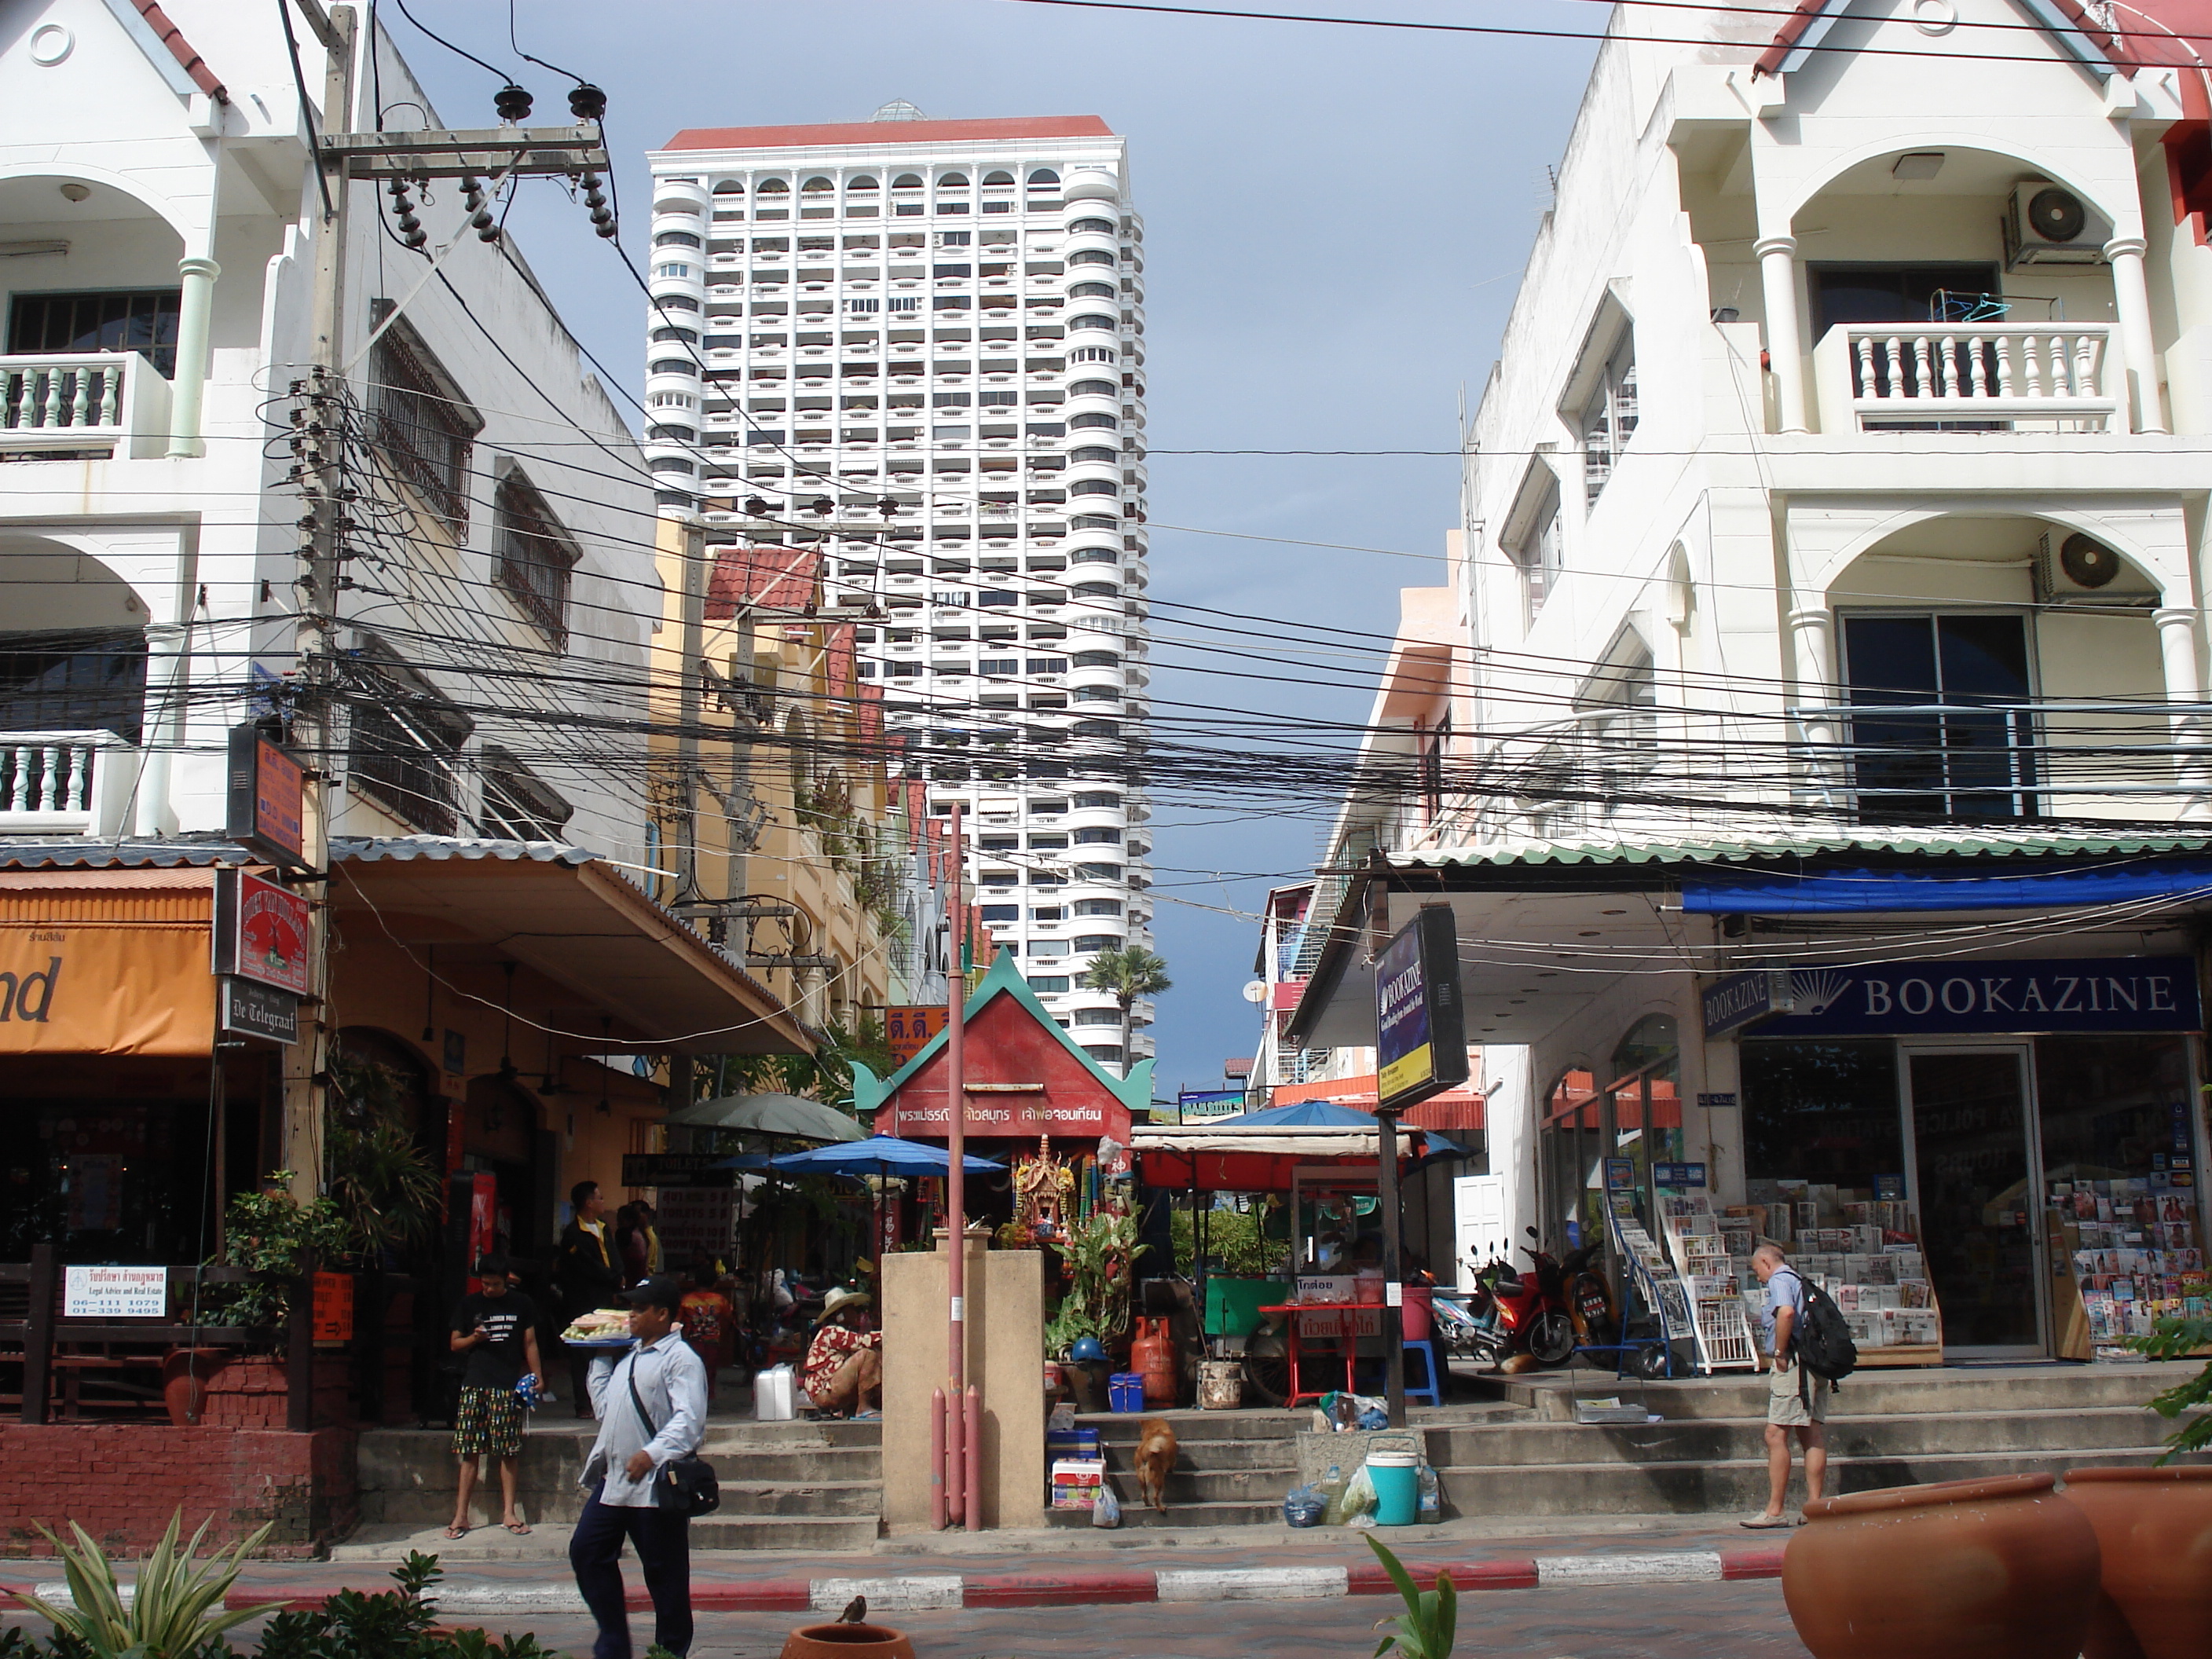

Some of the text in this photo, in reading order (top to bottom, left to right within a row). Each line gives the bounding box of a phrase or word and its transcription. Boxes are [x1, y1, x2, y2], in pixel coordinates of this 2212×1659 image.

[1387, 962, 1422, 1008] BOOKAZINE
[1706, 973, 1767, 1027] BOOKAZINE
[1865, 976, 2176, 1016] BOOKAZINE
[233, 998, 295, 1032] De Telegraaf
[89, 1287, 163, 1297] Legal Advice and Real Estate
